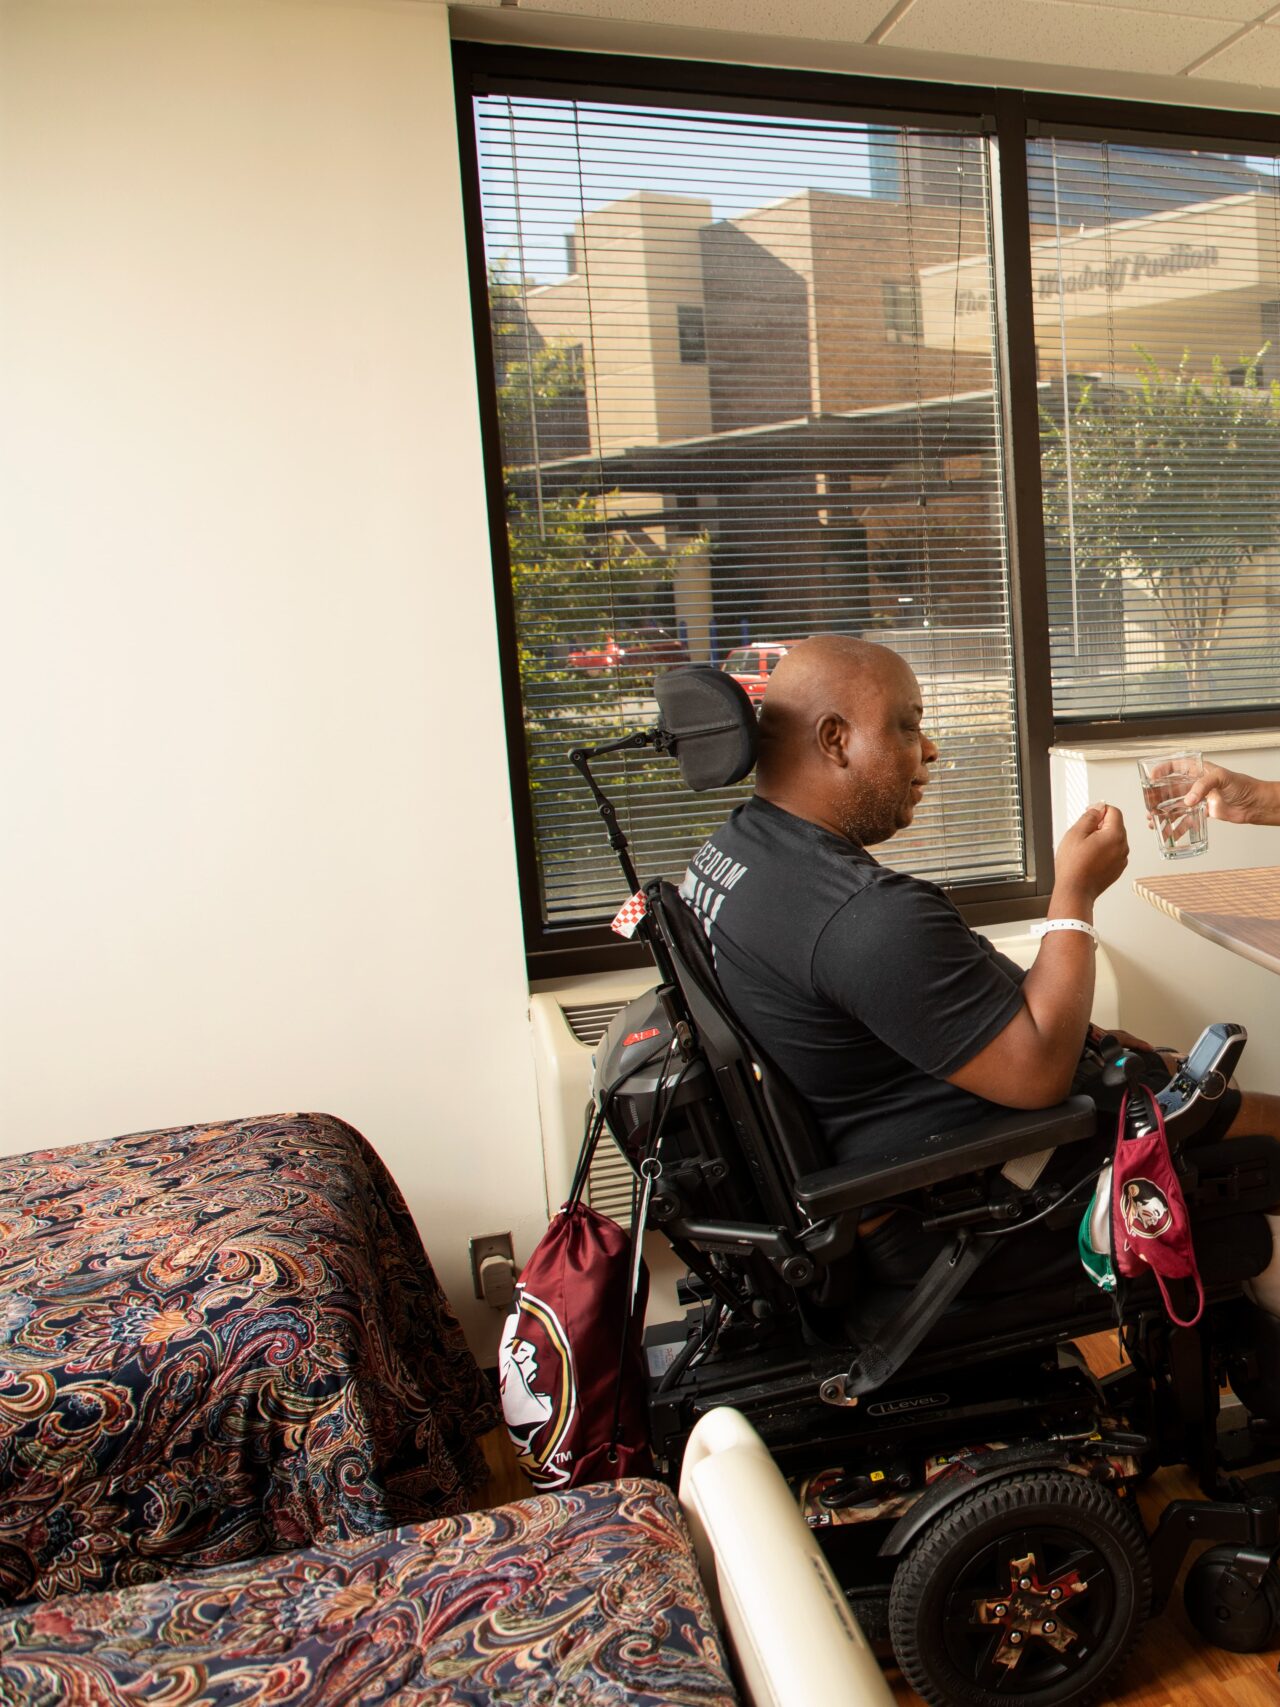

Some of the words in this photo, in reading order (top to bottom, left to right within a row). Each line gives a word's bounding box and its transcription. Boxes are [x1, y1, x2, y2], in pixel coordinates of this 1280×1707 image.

[1129, 244, 1219, 282] Pavilion
[693, 841, 748, 890] EEDOM
[555, 1451, 572, 1463] TM
